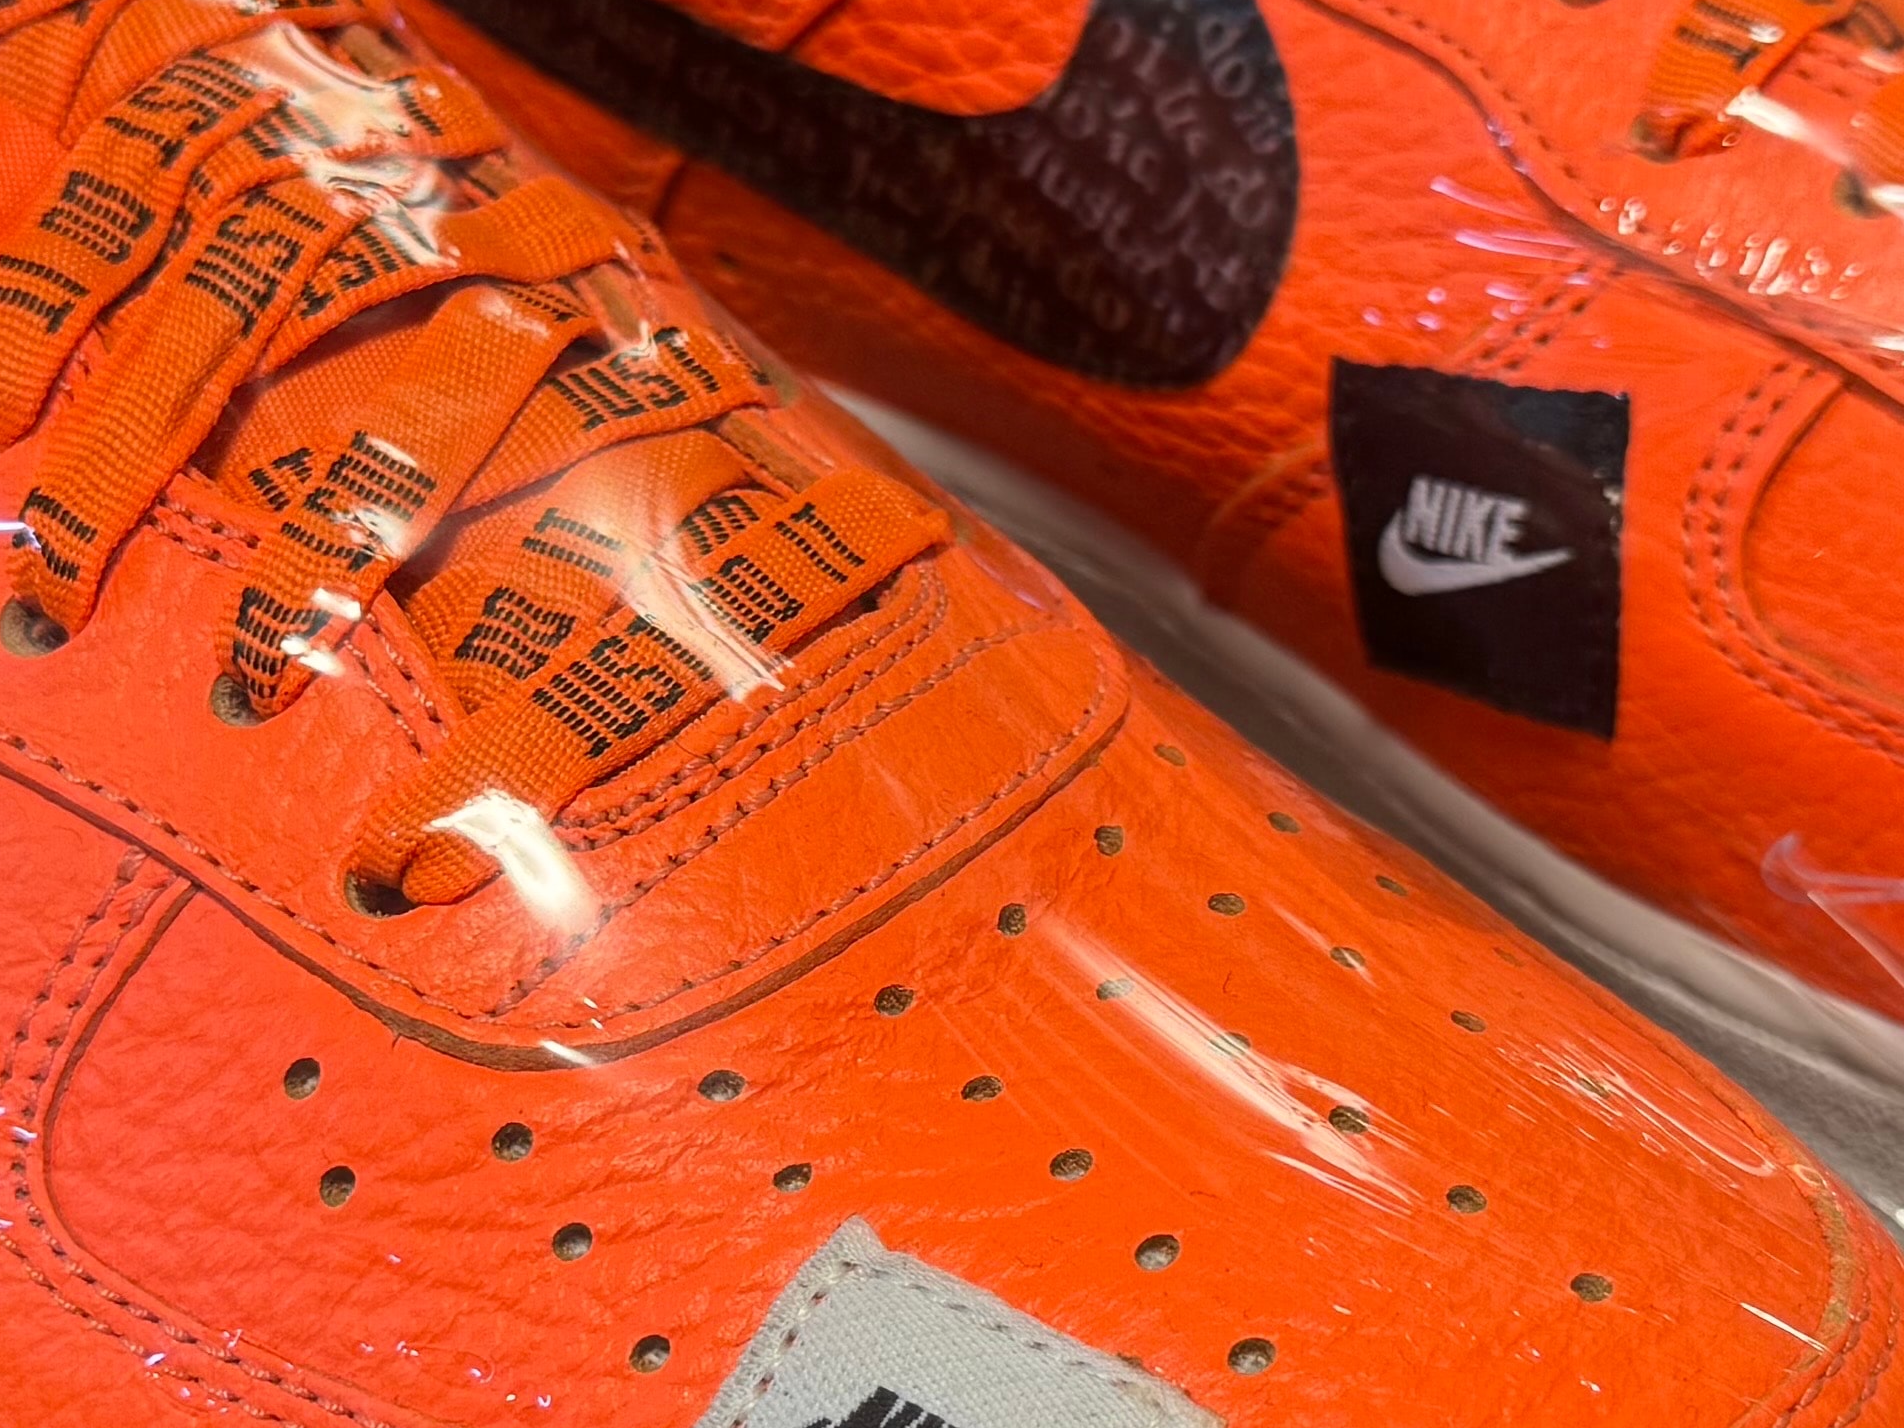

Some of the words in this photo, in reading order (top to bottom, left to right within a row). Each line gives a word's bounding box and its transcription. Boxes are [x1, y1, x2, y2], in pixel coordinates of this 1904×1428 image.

[102, 46, 276, 170] JUST
[40, 170, 157, 264] DO
[184, 184, 329, 340] JUST
[545, 325, 722, 432] JUST
[1403, 474, 1530, 565] NIKE
[452, 584, 580, 681] DO
[520, 506, 628, 578] IT
[531, 614, 716, 760] JUST
[773, 502, 867, 584] IT
